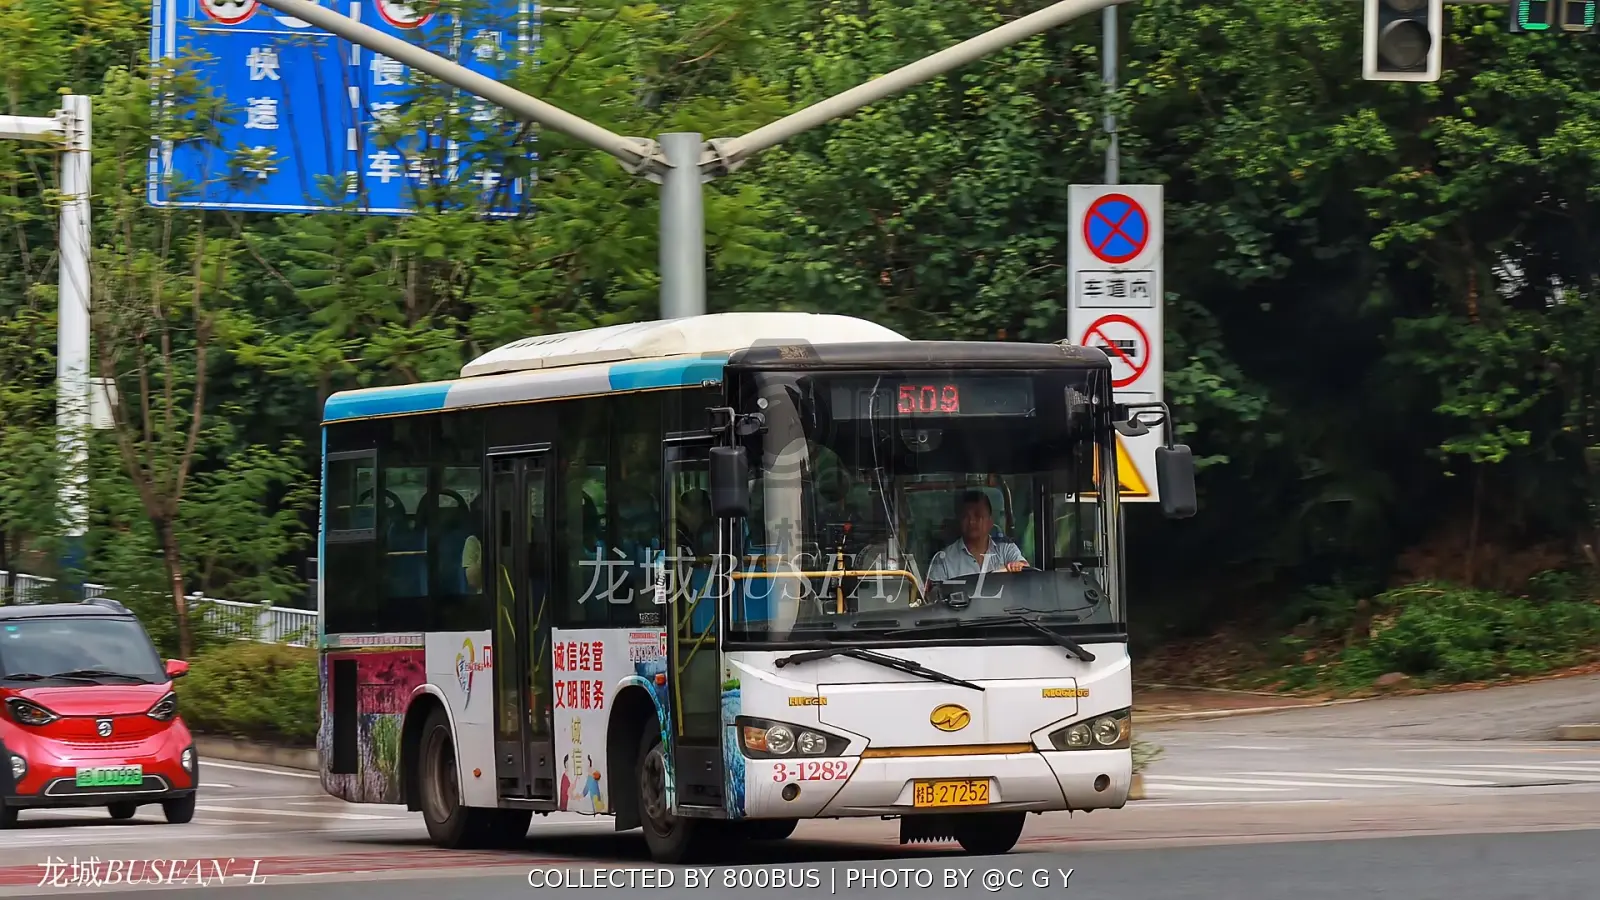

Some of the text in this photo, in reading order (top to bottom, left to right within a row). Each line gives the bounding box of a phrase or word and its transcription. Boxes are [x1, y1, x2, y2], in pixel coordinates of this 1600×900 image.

[897, 385, 960, 413] 509
[554, 641, 604, 672] 诚信经营
[555, 680, 604, 710] 文明服务
[773, 761, 849, 783] 3-1282
